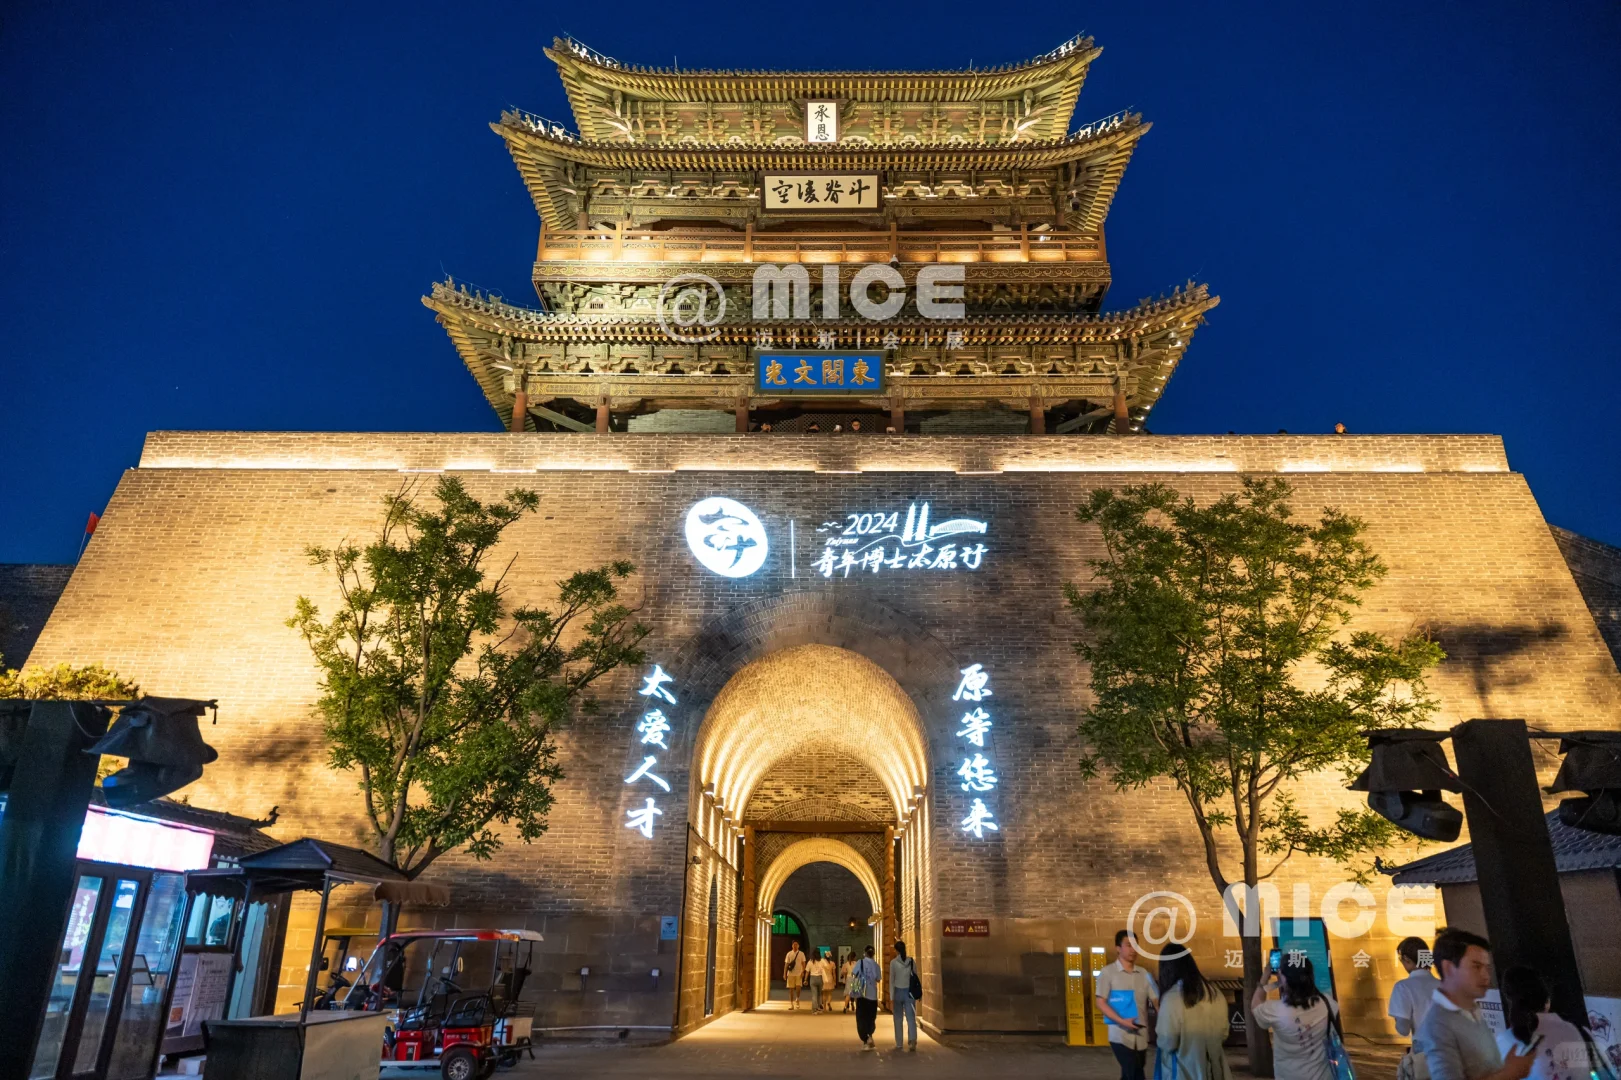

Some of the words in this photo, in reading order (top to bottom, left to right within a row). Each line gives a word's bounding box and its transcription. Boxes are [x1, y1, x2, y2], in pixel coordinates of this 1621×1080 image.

[814, 104, 831, 141] 承恩
[842, 511, 899, 536] 2024
[810, 543, 990, 579] 青年博士太原行
[624, 664, 677, 839] 太爱人才
[952, 663, 999, 839] 原等您来
